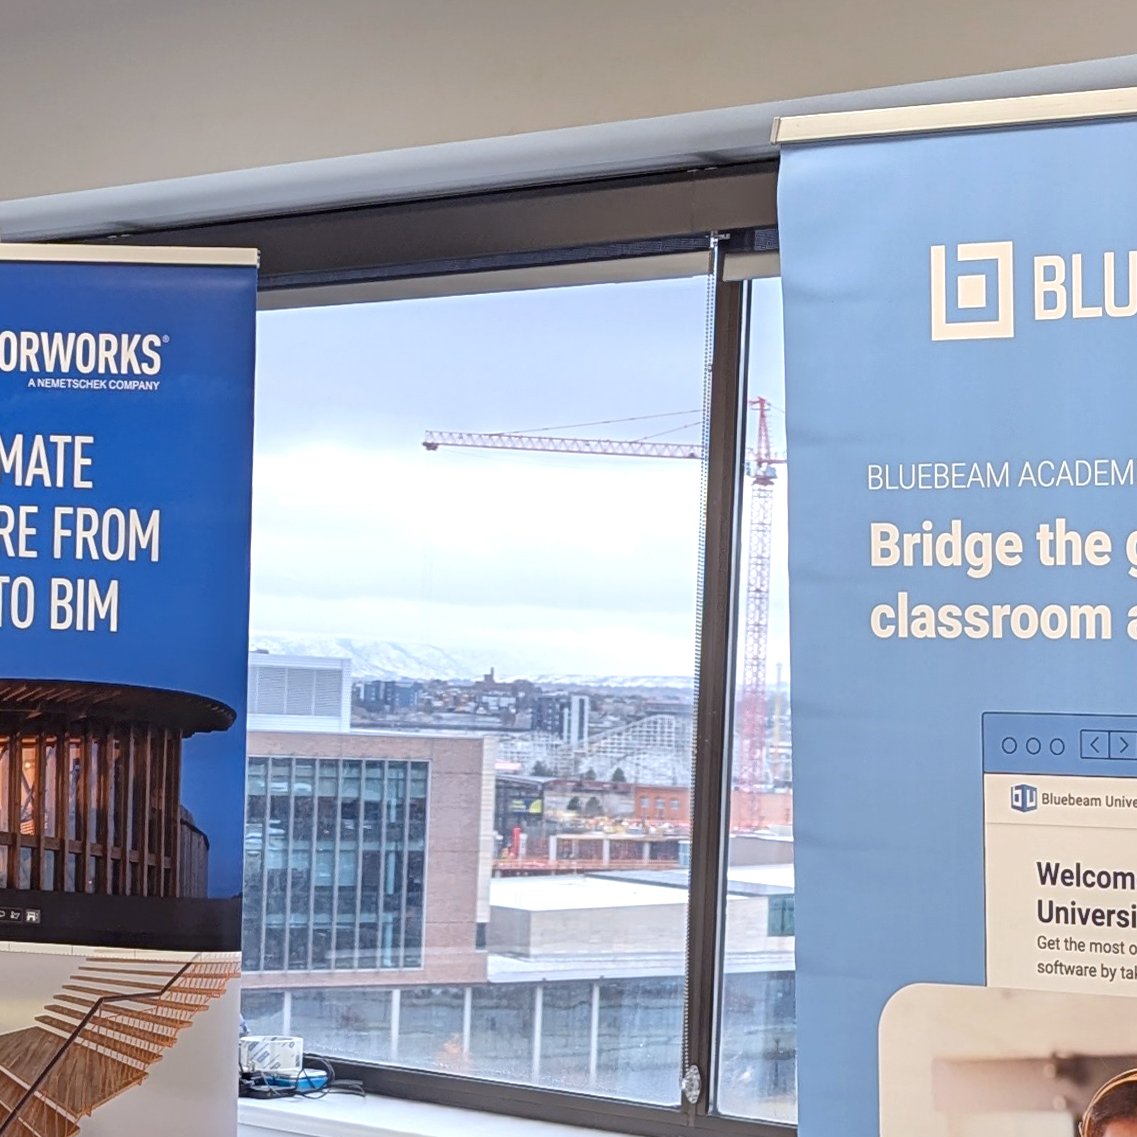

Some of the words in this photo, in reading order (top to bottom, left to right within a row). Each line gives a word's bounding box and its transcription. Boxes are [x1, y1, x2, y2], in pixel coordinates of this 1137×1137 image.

[27, 378, 36, 388] A
[37, 378, 107, 390] NEMETSCHEK
[108, 379, 161, 391] COMPANY
[0, 434, 94, 488] MATE
[867, 461, 1010, 490] BLUEBEAM
[0, 504, 39, 559] RE
[53, 506, 161, 562] FROM
[870, 519, 1024, 579] Bridge
[1036, 518, 1113, 566] the
[50, 577, 118, 632] BIM
[870, 591, 1112, 639] classroom
[1041, 793, 1102, 808] Bluebeam
[1036, 935, 1061, 951] Get
[1064, 937, 1086, 952] the
[1089, 939, 1125, 955] most
[1036, 960, 1097, 977] software
[1100, 963, 1117, 982] by
